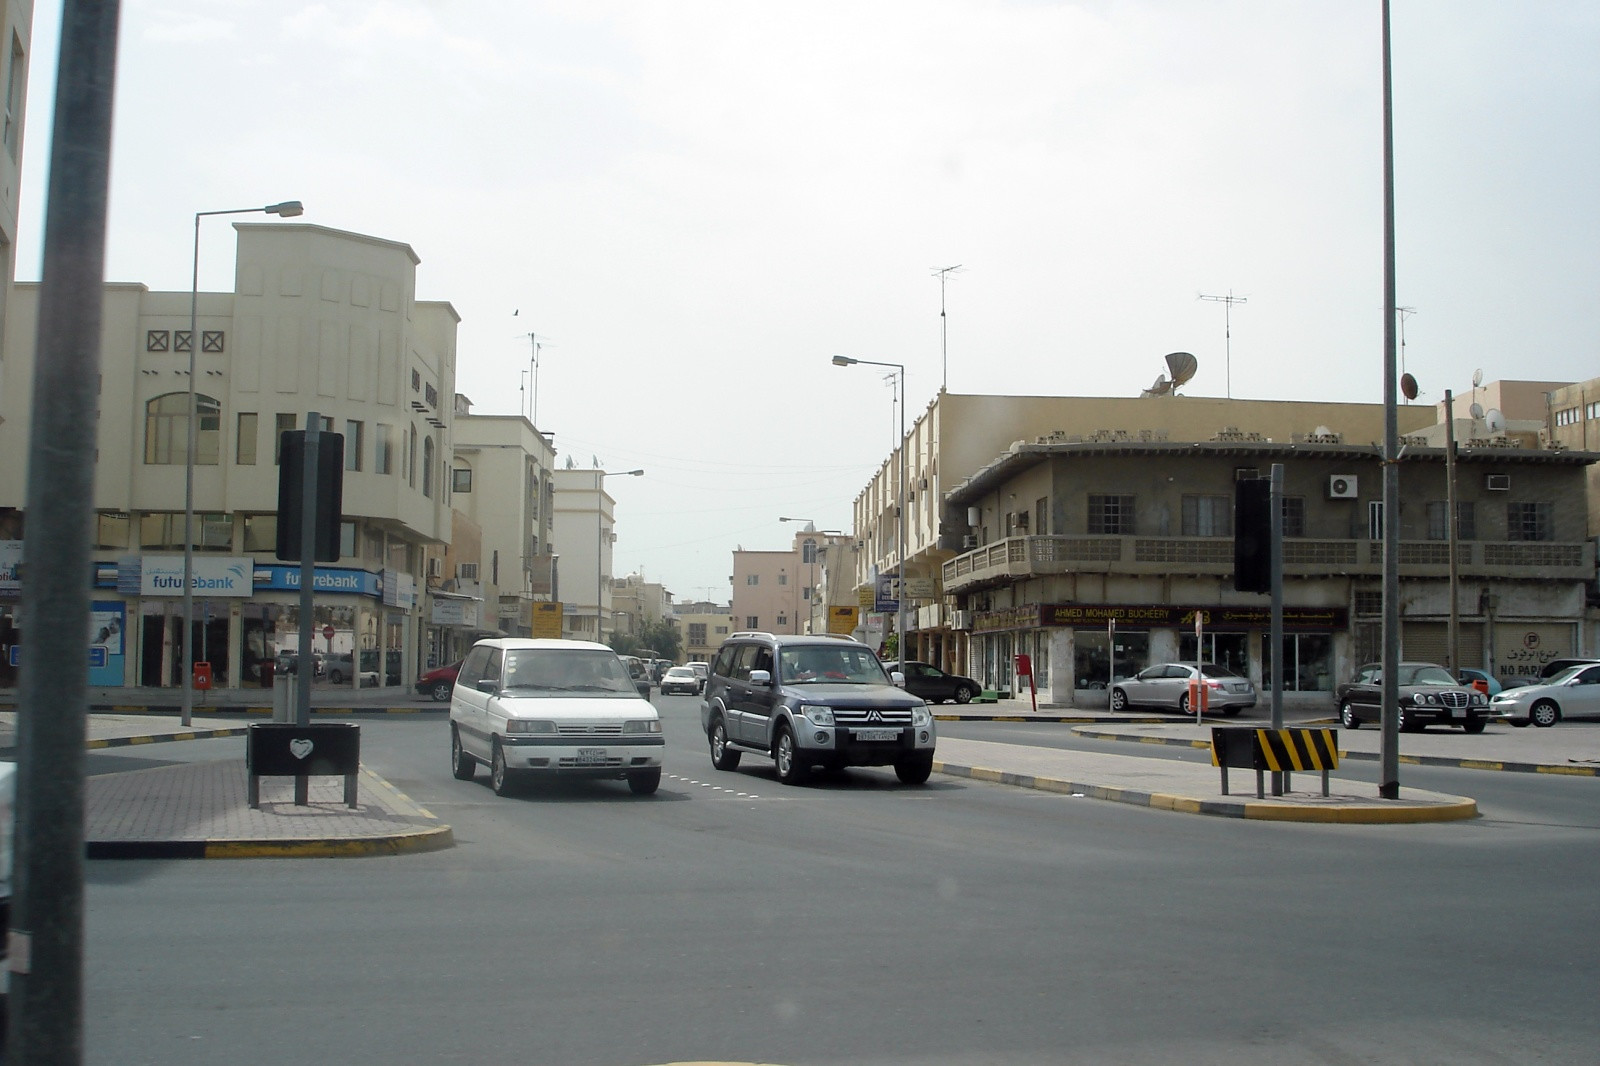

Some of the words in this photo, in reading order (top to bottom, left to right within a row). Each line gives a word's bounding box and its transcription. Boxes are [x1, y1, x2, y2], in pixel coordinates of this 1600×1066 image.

[153, 575, 234, 589] futuebank
[285, 571, 358, 588] furebank
[1054, 608, 1083, 618] AHMED
[1085, 608, 1125, 618] MOHAMED
[1128, 609, 1169, 619] BUCHEERY
[1506, 648, 1538, 661] الوقوف
[1539, 650, 1559, 664] ممنوع
[1500, 665, 1515, 675] NO
